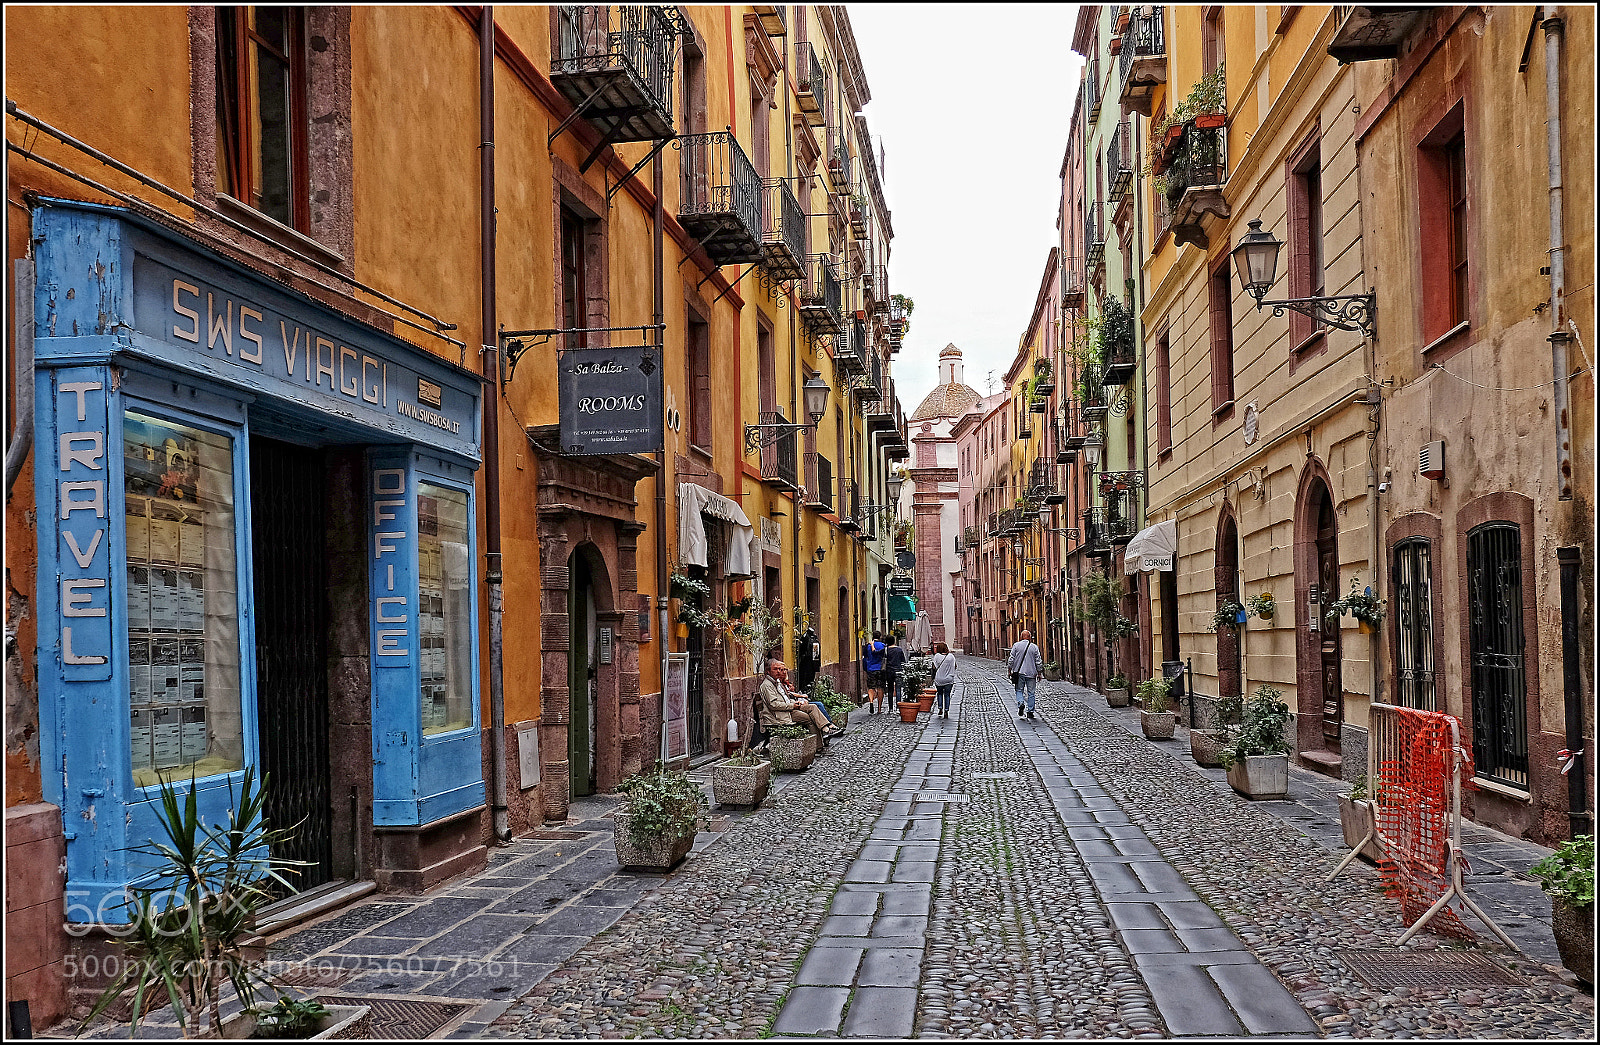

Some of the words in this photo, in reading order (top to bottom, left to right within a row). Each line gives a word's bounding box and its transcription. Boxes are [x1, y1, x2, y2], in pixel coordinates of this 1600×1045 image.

[173, 279, 263, 365] SWS
[280, 320, 387, 407] VIAGGI
[397, 399, 460, 434] WWW.SWSBOSA.IT
[578, 394, 645, 415] ROOMS
[59, 381, 109, 665] TRAVEL
[373, 467, 409, 657] OFFICE
[1144, 558, 1171, 567] CORNICI
